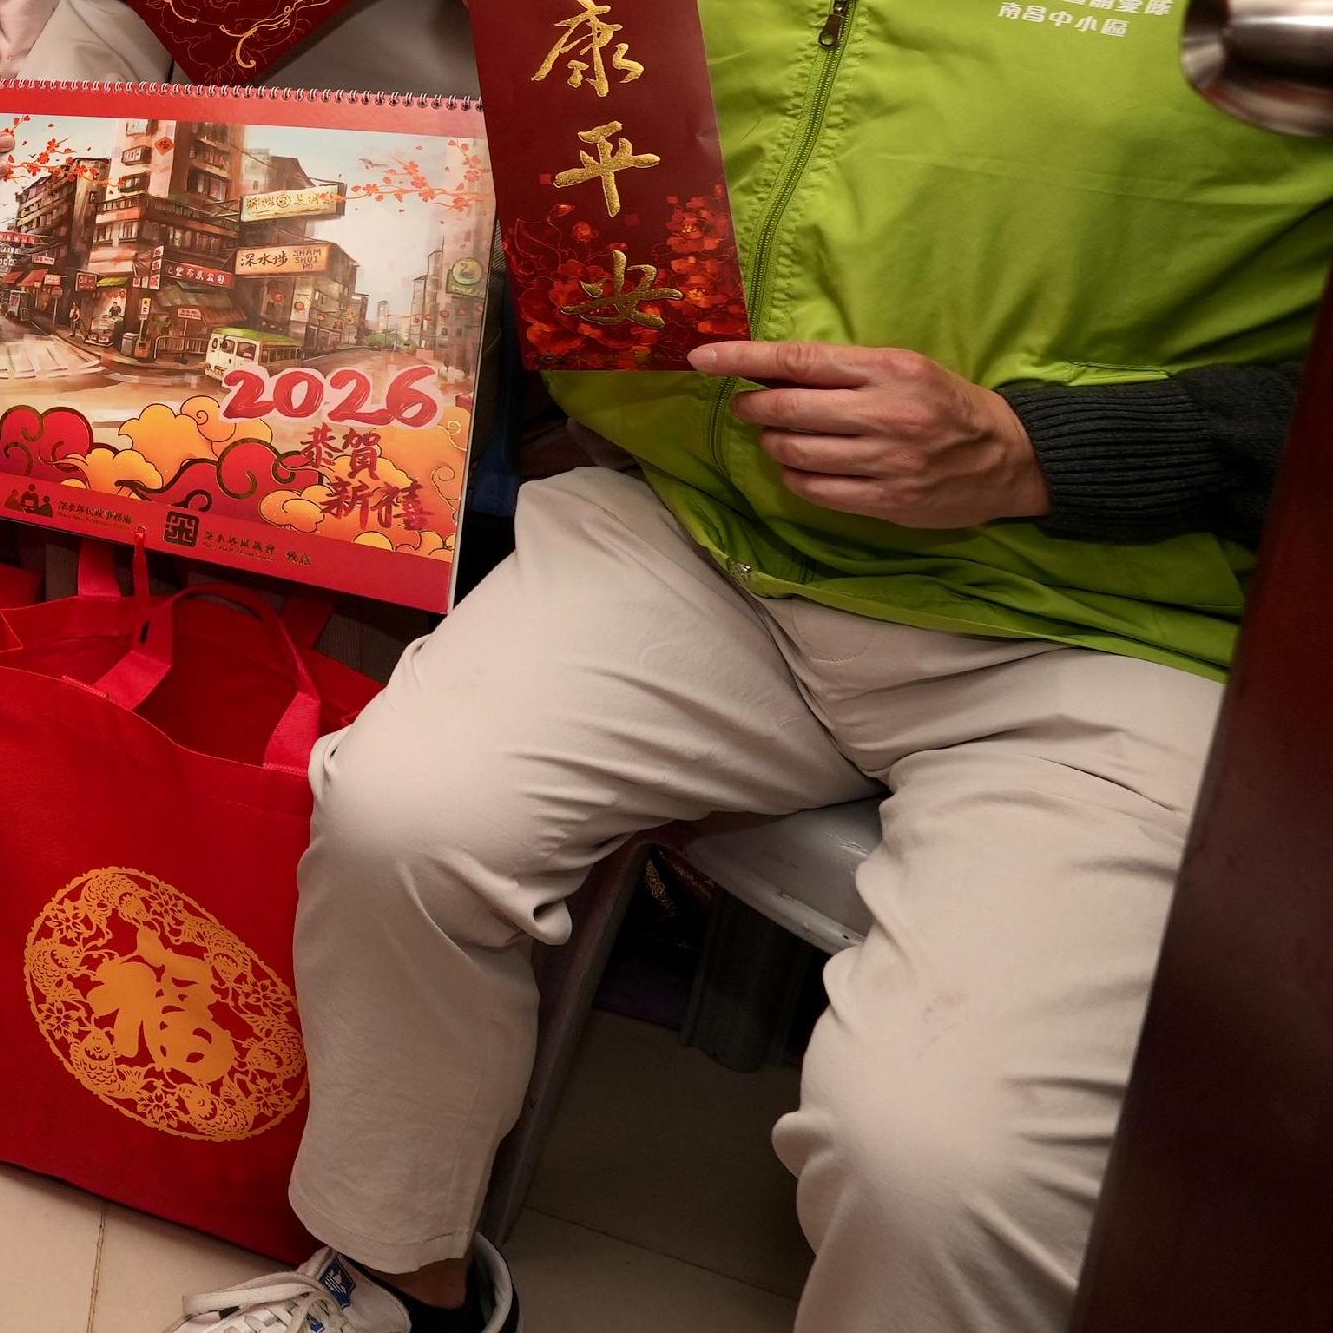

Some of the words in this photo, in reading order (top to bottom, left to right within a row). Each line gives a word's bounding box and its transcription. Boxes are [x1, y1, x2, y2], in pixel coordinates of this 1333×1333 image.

[998, 1, 1130, 37] 南昌中小區
[240, 250, 288, 267] 深水埗
[292, 249, 321, 257] SHAM
[222, 365, 438, 428] 2026
[300, 423, 381, 480] 恭賀
[319, 477, 434, 531] 新禧
[86, 925, 234, 1083] 福
